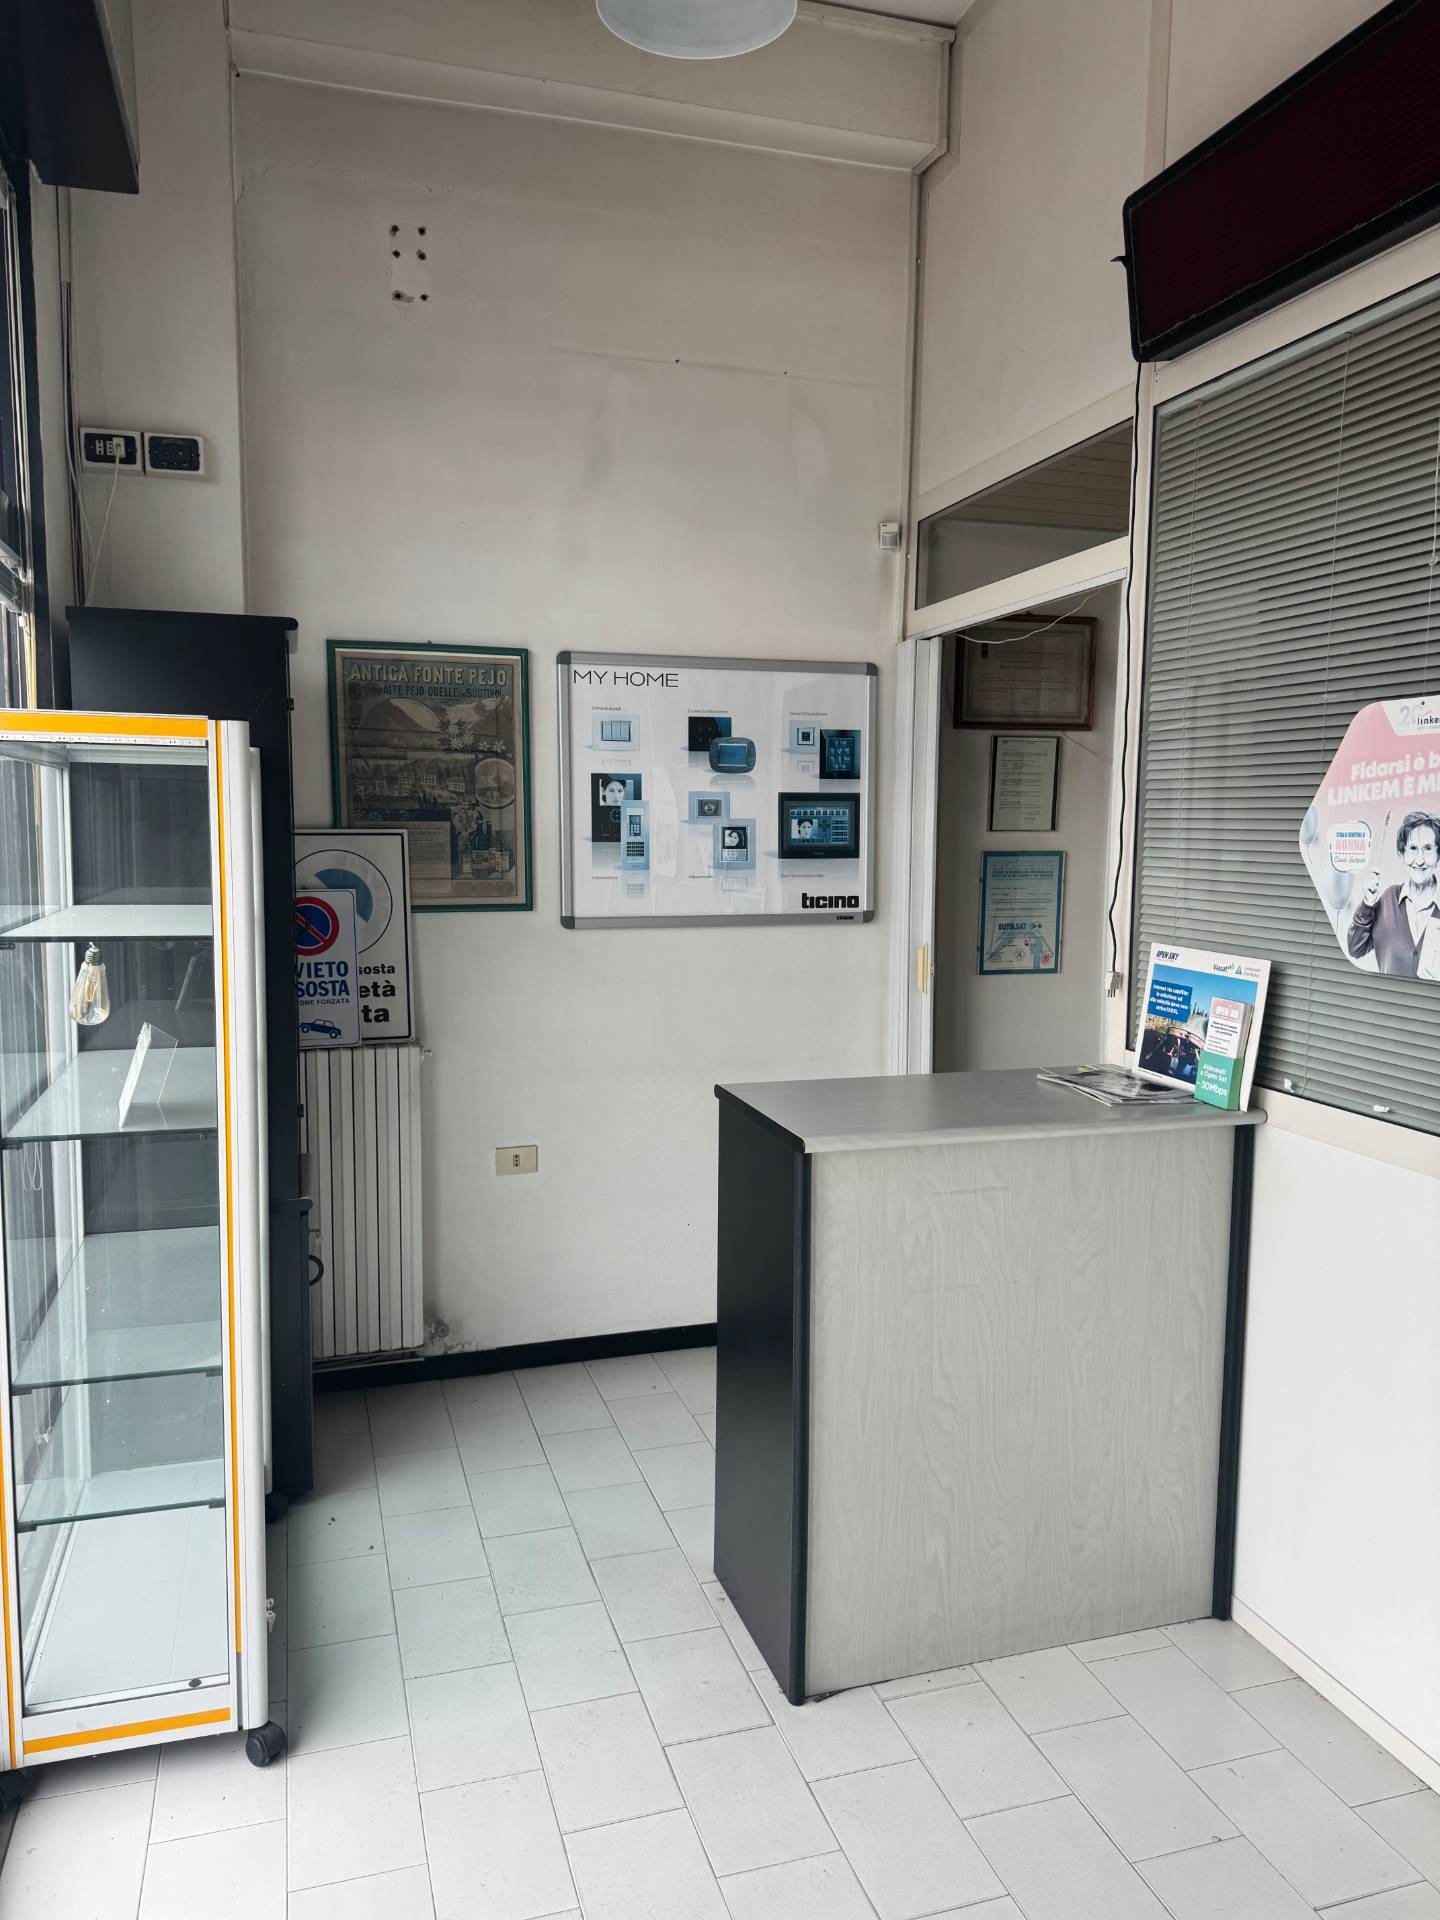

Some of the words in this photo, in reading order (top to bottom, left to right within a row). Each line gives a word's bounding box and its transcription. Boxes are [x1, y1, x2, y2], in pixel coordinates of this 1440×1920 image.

[350, 664, 409, 682] ANTICA
[414, 666, 464, 685] FONTE
[469, 669, 507, 686] PEJO
[573, 670, 608, 685] MY
[614, 672, 679, 687] HOME
[384, 685, 401, 696] ALTE
[406, 686, 424, 697] PEJO
[428, 686, 459, 698] QUELLE
[1417, 715, 1440, 726] linke
[1351, 754, 1411, 781] Fidarsi
[1413, 752, 1425, 771] è
[1327, 779, 1400, 806] LINKEM
[1403, 774, 1415, 796] È
[801, 893, 860, 909] ticino
[1156, 950, 1169, 958] OPEN
[296, 980, 350, 997] SOSTA
[359, 980, 396, 998] età
[361, 1005, 390, 1023] ta
[1202, 1063, 1225, 1075] Abbonati
[1204, 1070, 1217, 1080] Open
